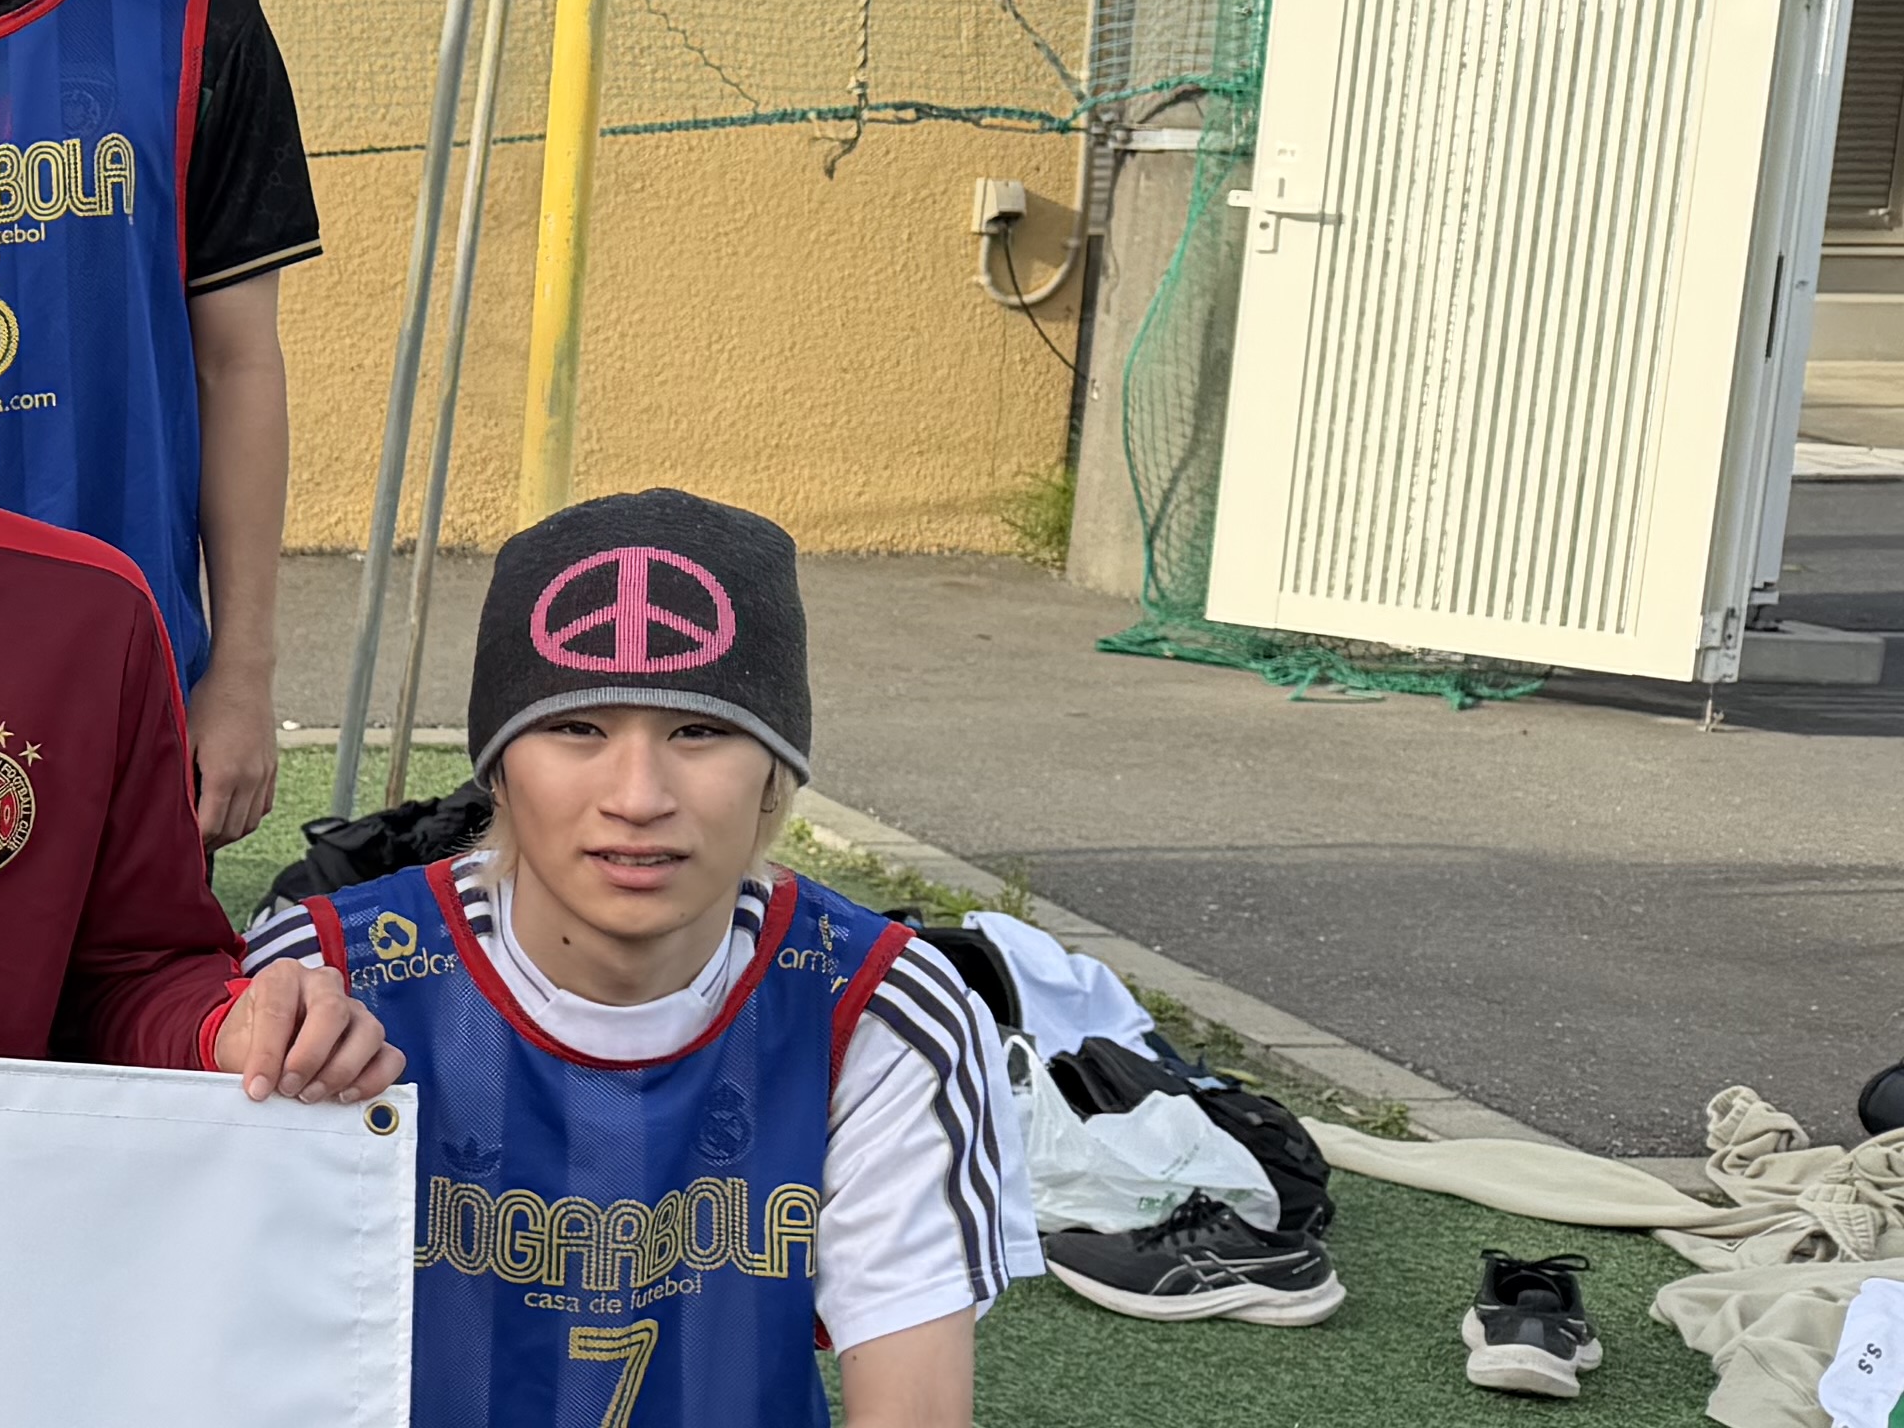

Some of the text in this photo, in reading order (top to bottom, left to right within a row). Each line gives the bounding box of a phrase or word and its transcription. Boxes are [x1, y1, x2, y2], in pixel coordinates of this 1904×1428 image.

[413, 1177, 819, 1291] JOGARBOLA
[524, 1272, 703, 1314] casa de futebol
